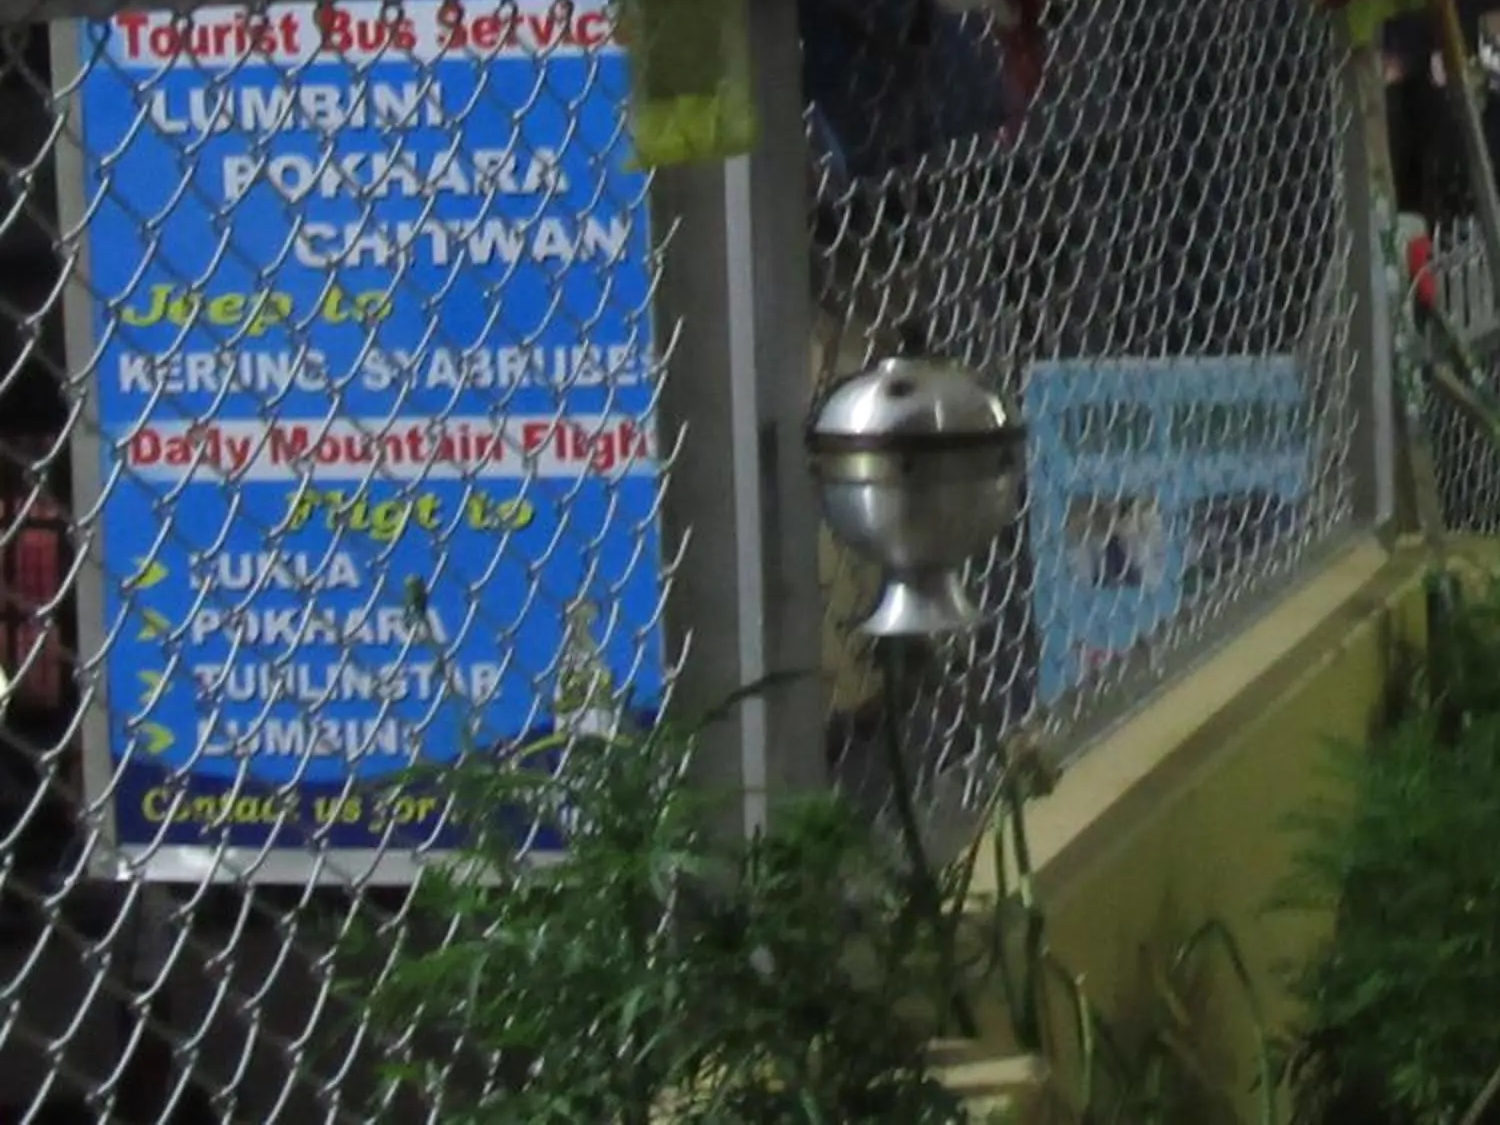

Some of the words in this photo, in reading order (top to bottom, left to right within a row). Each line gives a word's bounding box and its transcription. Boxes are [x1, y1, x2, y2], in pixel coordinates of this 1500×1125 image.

[116, 11, 300, 59] Tourist
[320, 4, 416, 52] Bus
[151, 83, 443, 134] LUMBINI
[223, 149, 570, 200] POKHARA
[296, 216, 627, 268] CHITWAN
[121, 283, 292, 337] Jeep
[320, 285, 393, 324] to
[131, 426, 251, 472] Daily
[270, 421, 504, 465] Mountain
[523, 421, 653, 473] Fligh
[467, 491, 534, 530] to
[189, 552, 361, 590] LUKLA
[190, 608, 449, 645] POKHARA
[314, 793, 362, 823] us
